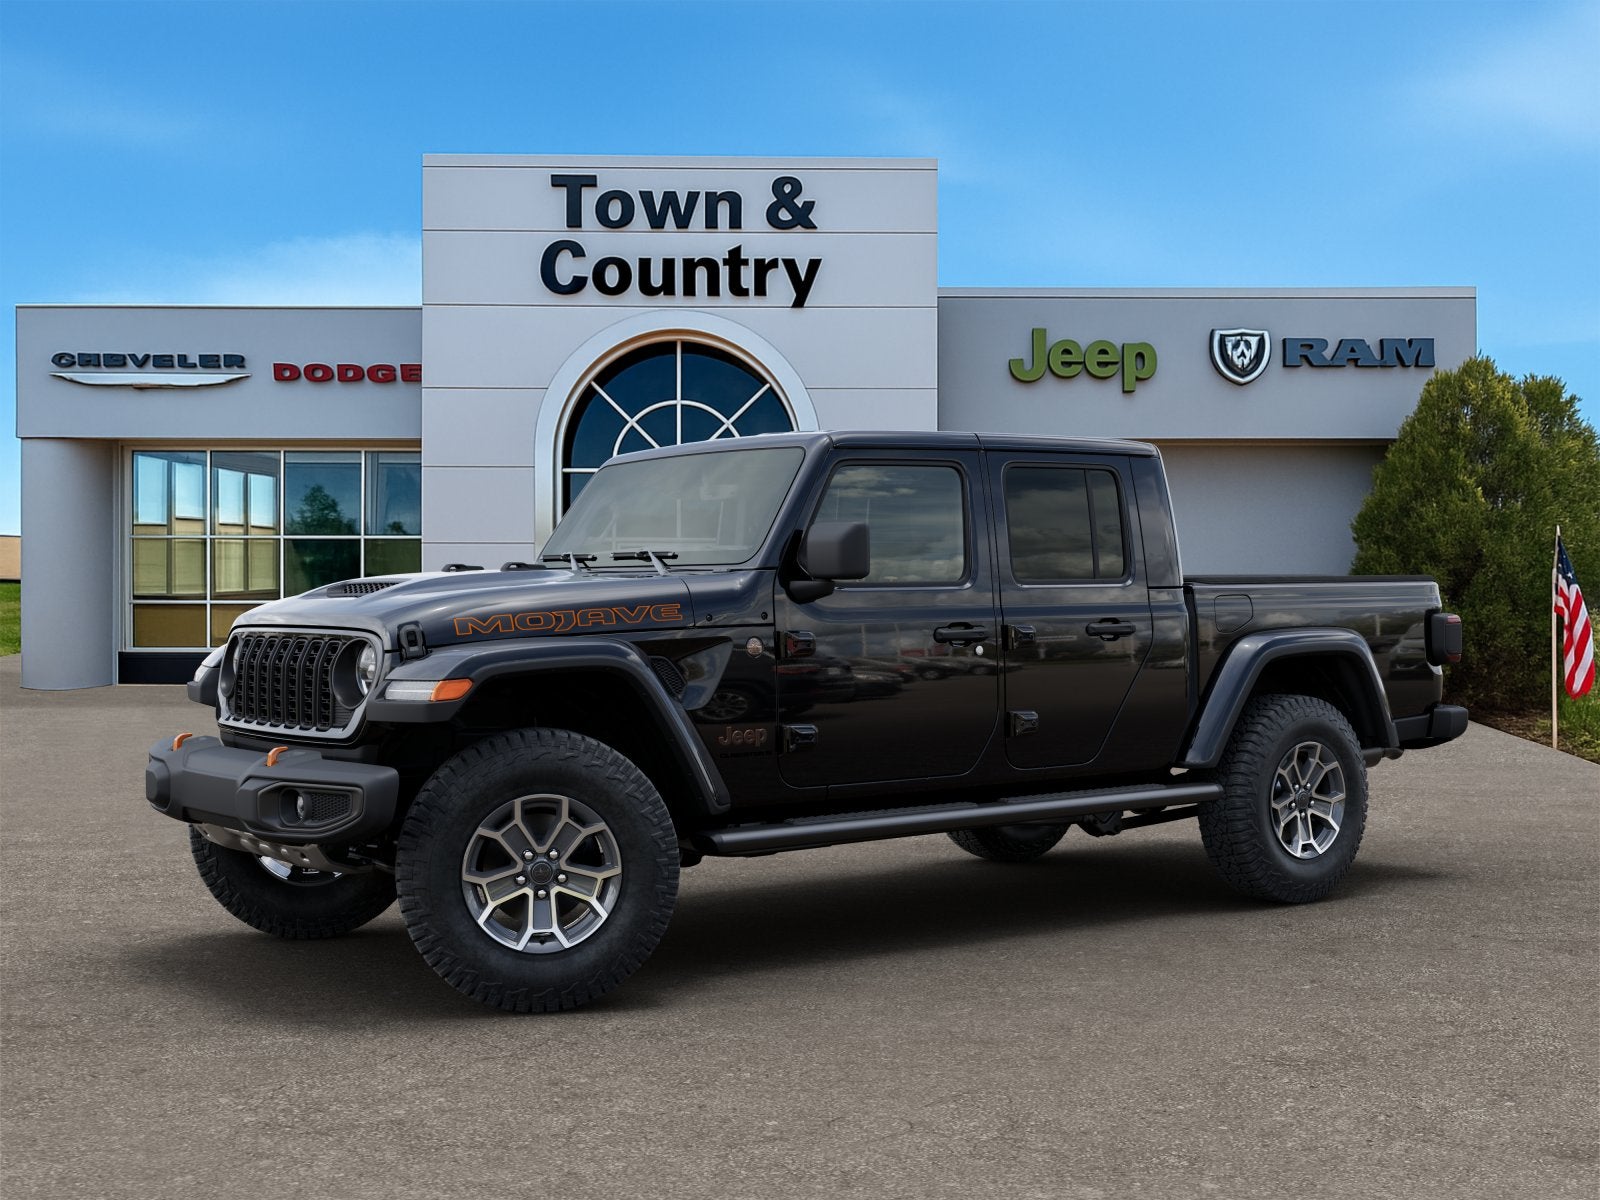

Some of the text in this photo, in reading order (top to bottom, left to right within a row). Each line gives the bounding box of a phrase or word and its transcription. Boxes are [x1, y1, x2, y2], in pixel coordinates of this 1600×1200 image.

[550, 174, 818, 230] Town &
[540, 239, 822, 308] Country
[1009, 328, 1157, 393] Jeep
[1282, 337, 1435, 367] RAM
[272, 362, 422, 383] DODGE
[453, 603, 683, 636] MOJAVE
[718, 725, 768, 748] Jeep
